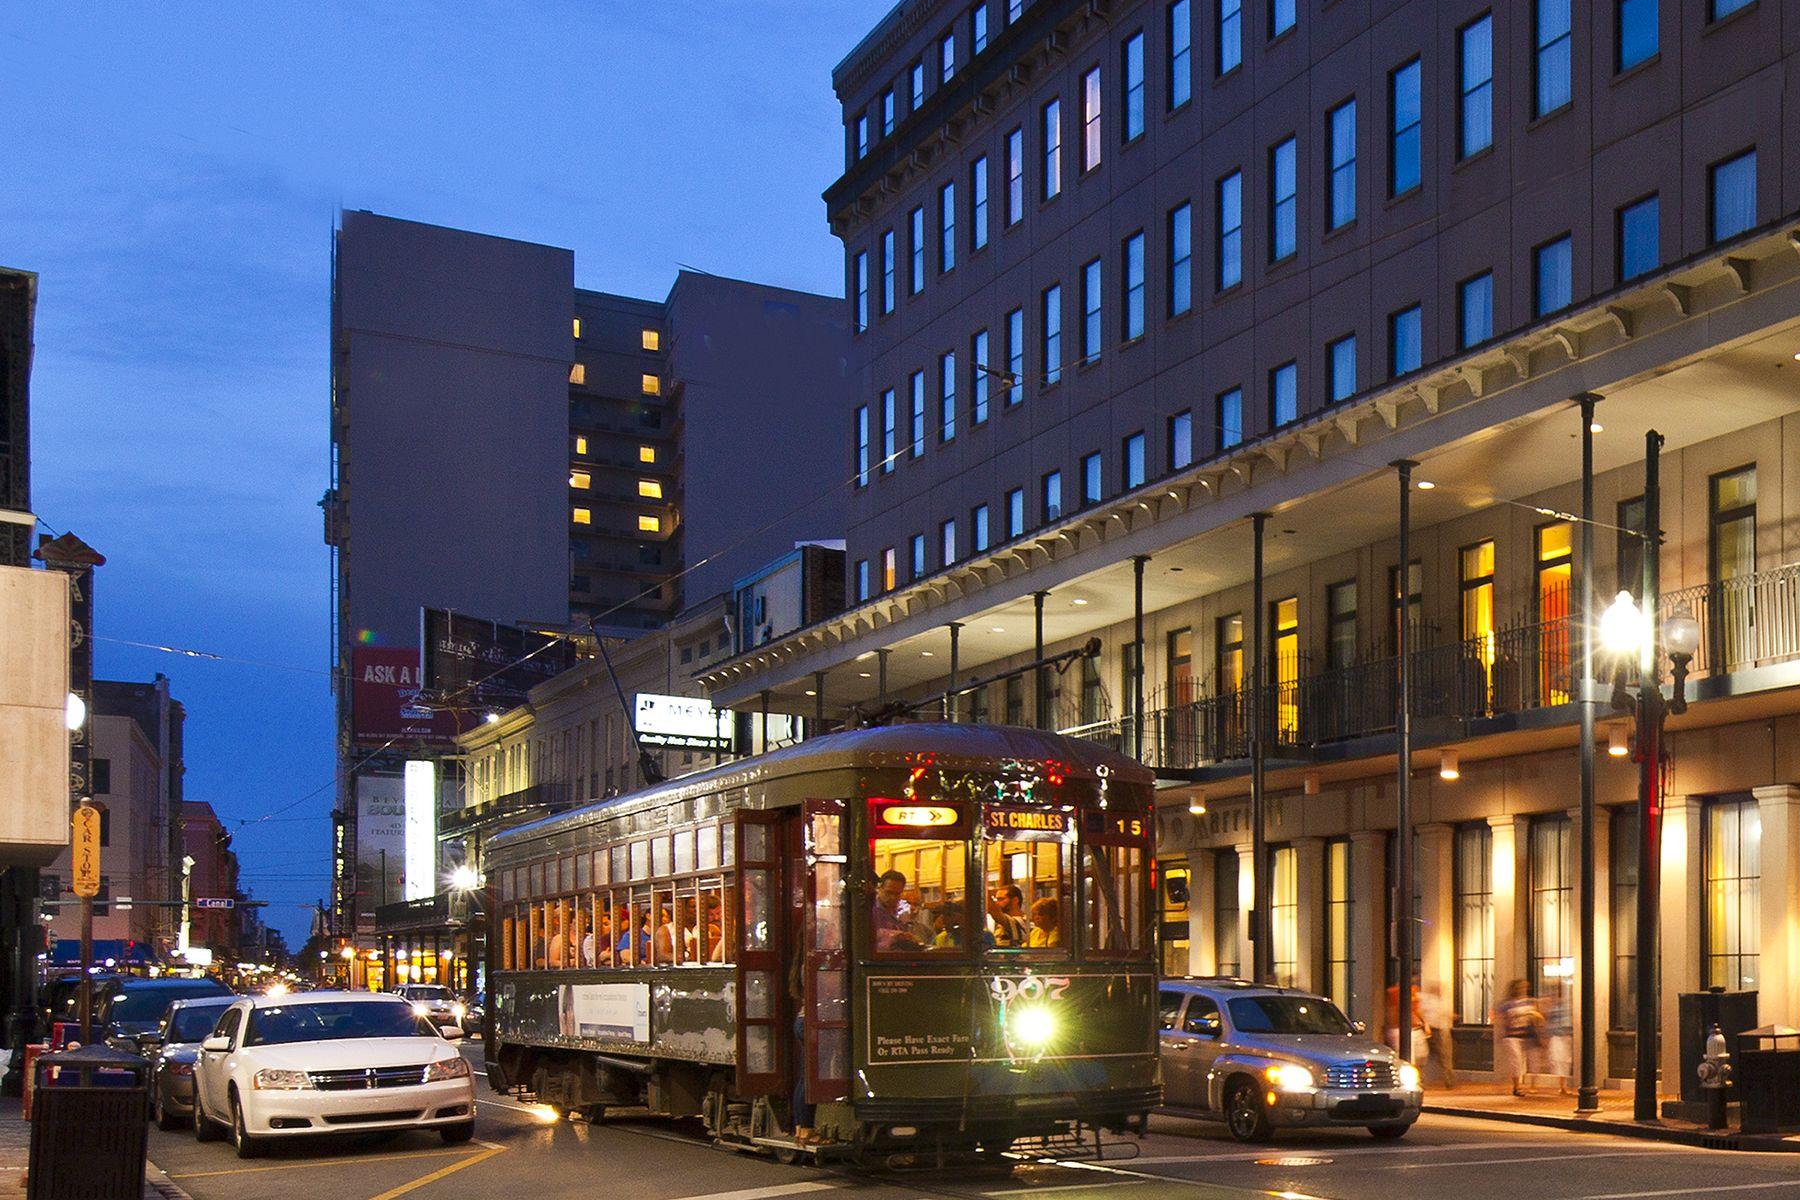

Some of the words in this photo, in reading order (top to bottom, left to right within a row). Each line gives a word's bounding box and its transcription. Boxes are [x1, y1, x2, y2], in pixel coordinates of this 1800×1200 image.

[364, 665, 395, 684] ASK
[400, 666, 410, 684] A
[990, 812, 1008, 827] ST.
[1009, 812, 1062, 830] CHARLES
[991, 975, 1071, 1001] 907
[877, 1036, 902, 1045] Please
[904, 1035, 924, 1045] Have
[926, 1034, 950, 1044] Exact
[952, 1033, 970, 1043] Fare
[877, 1046, 888, 1056] Or
[891, 1046, 908, 1056] RTA
[911, 1046, 928, 1055] Pass
[930, 1045, 955, 1056] Ready
